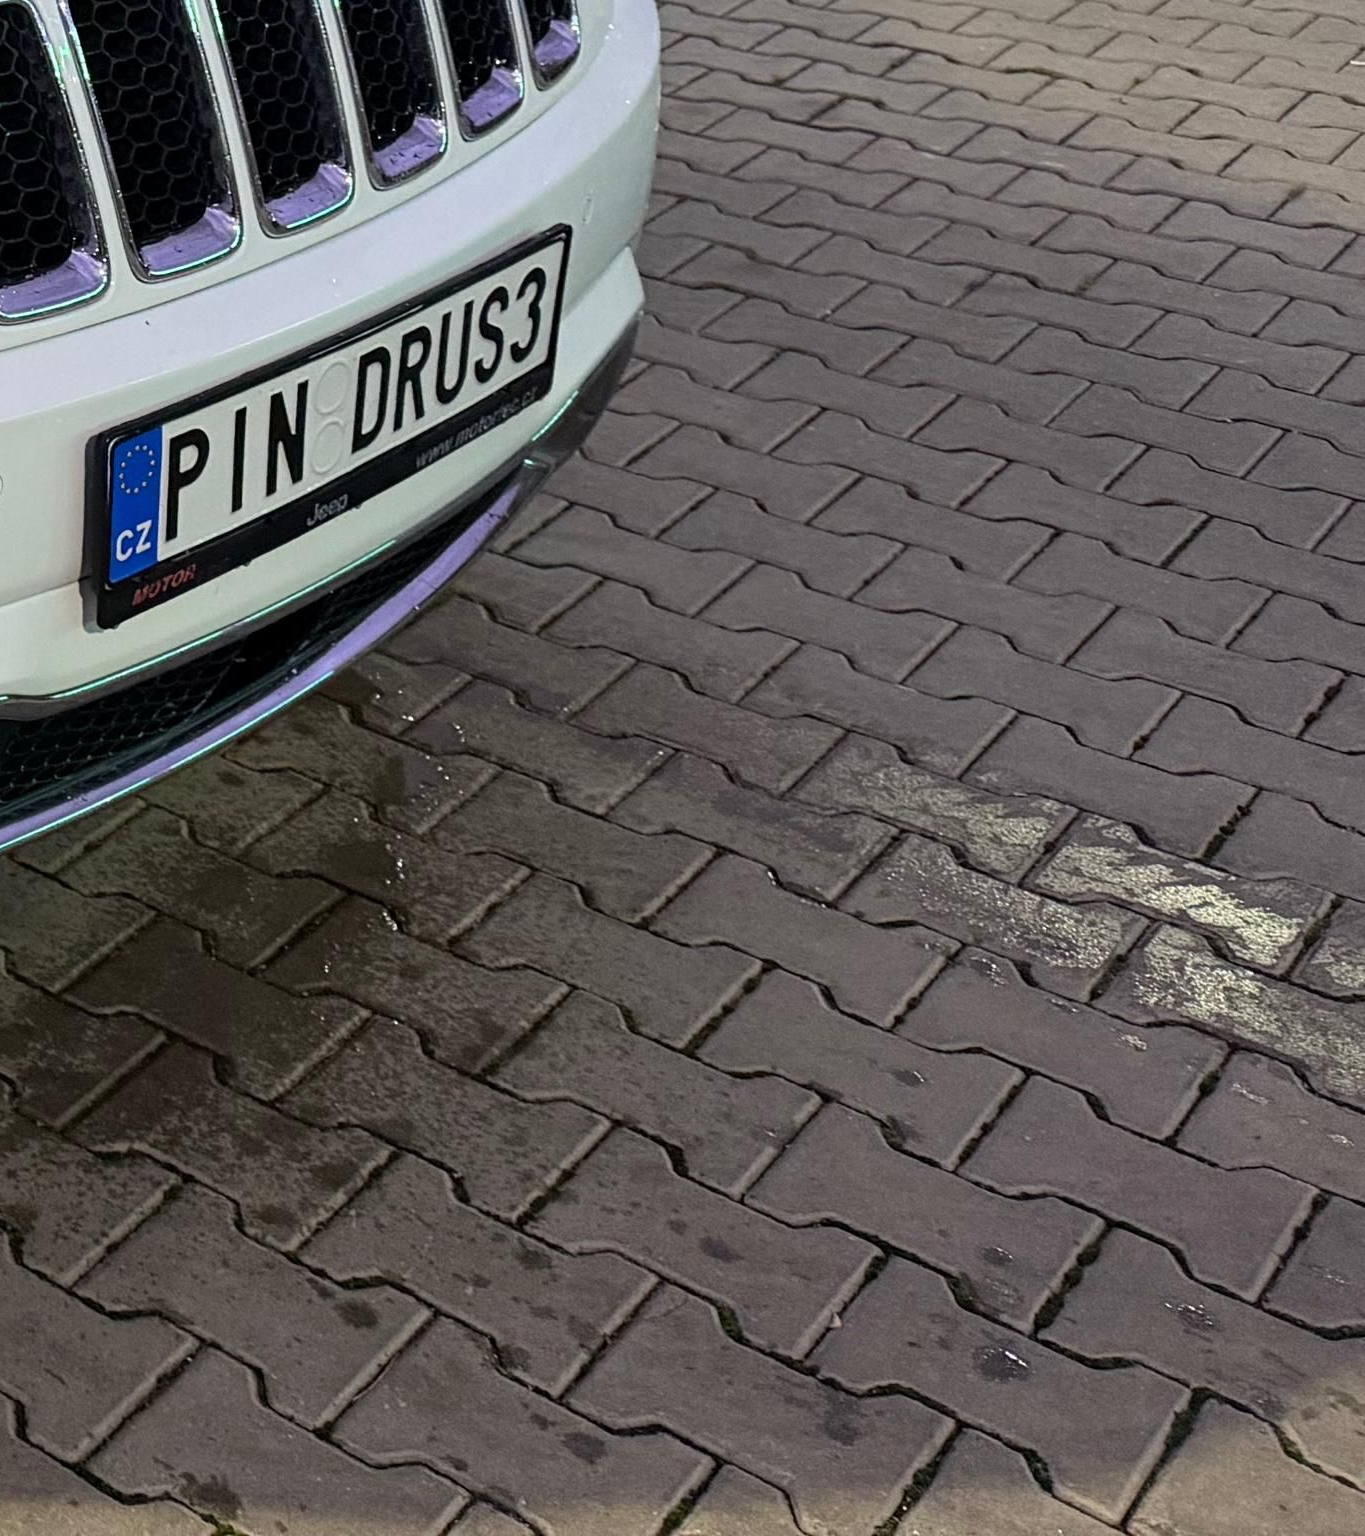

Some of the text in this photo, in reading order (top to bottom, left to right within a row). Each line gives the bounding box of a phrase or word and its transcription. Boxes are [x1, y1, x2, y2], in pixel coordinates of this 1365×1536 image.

[165, 267, 547, 542] PIN DRUS3
[115, 519, 152, 562] CZ
